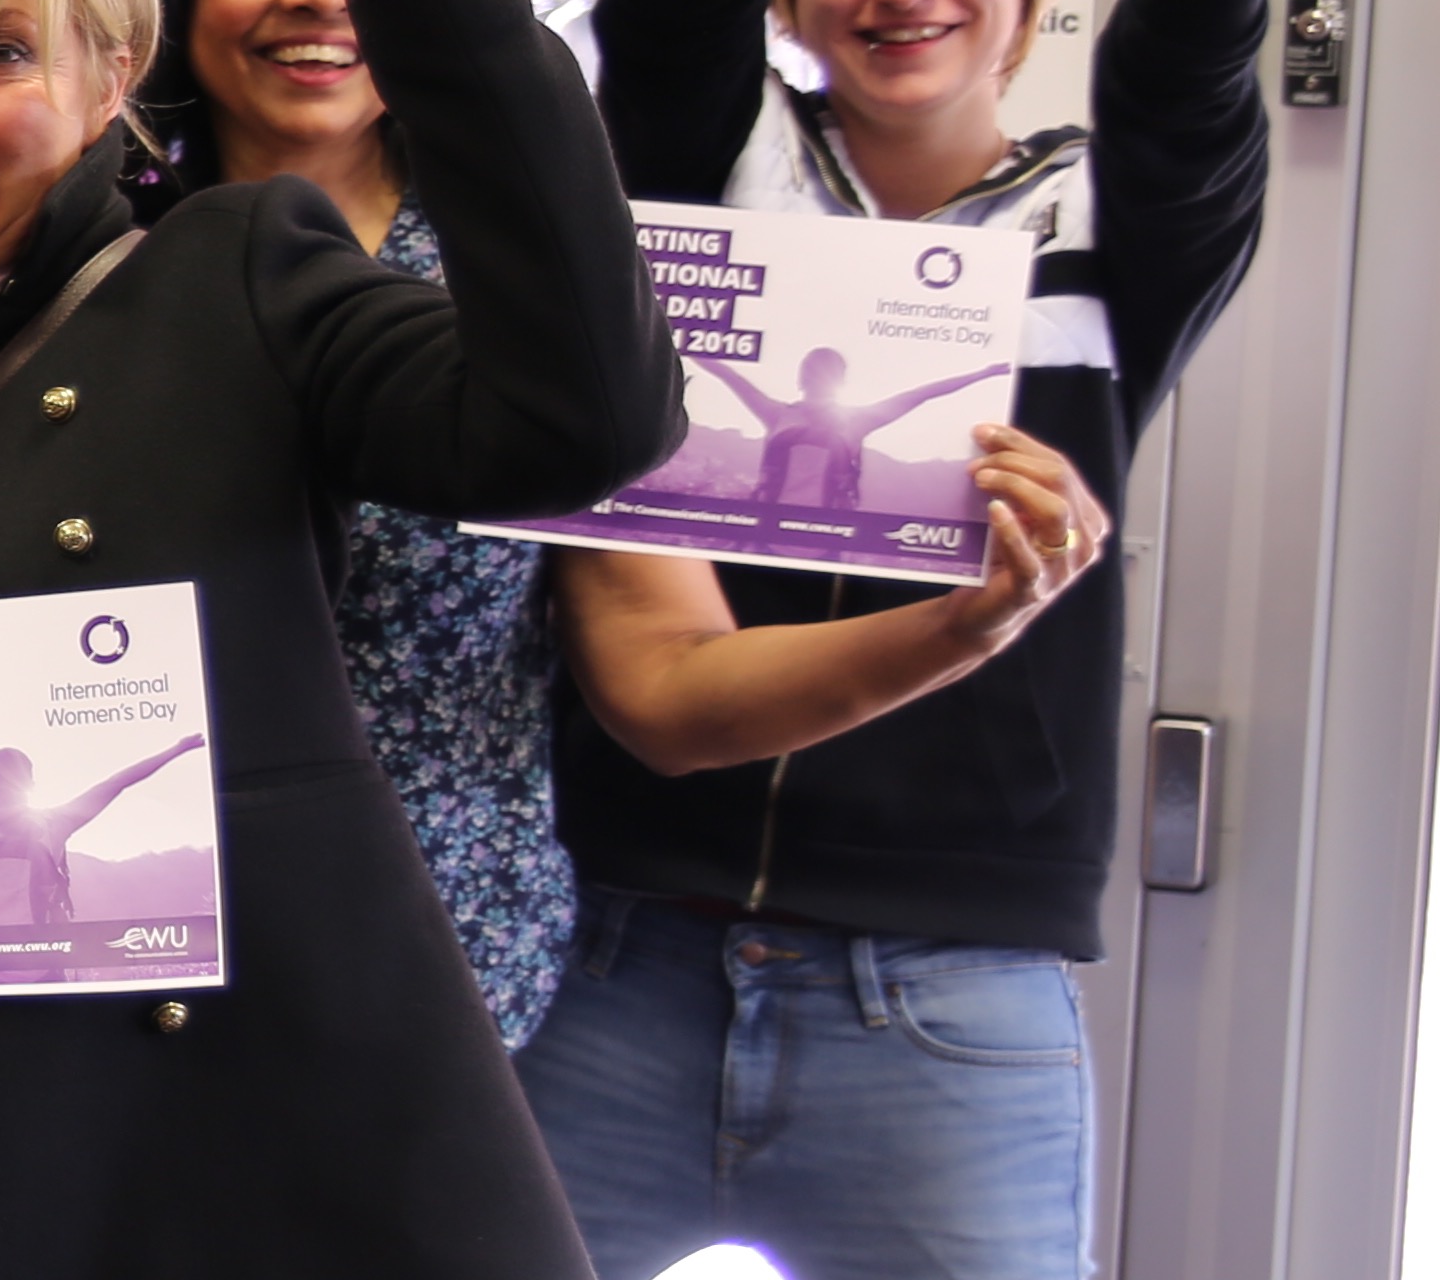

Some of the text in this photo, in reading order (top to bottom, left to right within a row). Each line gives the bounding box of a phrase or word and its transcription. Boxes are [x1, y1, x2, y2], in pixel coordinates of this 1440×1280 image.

[669, 297, 727, 321] DAY
[877, 299, 989, 322] International
[688, 331, 753, 356] 2016
[956, 327, 993, 349] Day
[50, 674, 169, 701] International
[139, 699, 177, 724] Day
[121, 925, 188, 950] CWU
